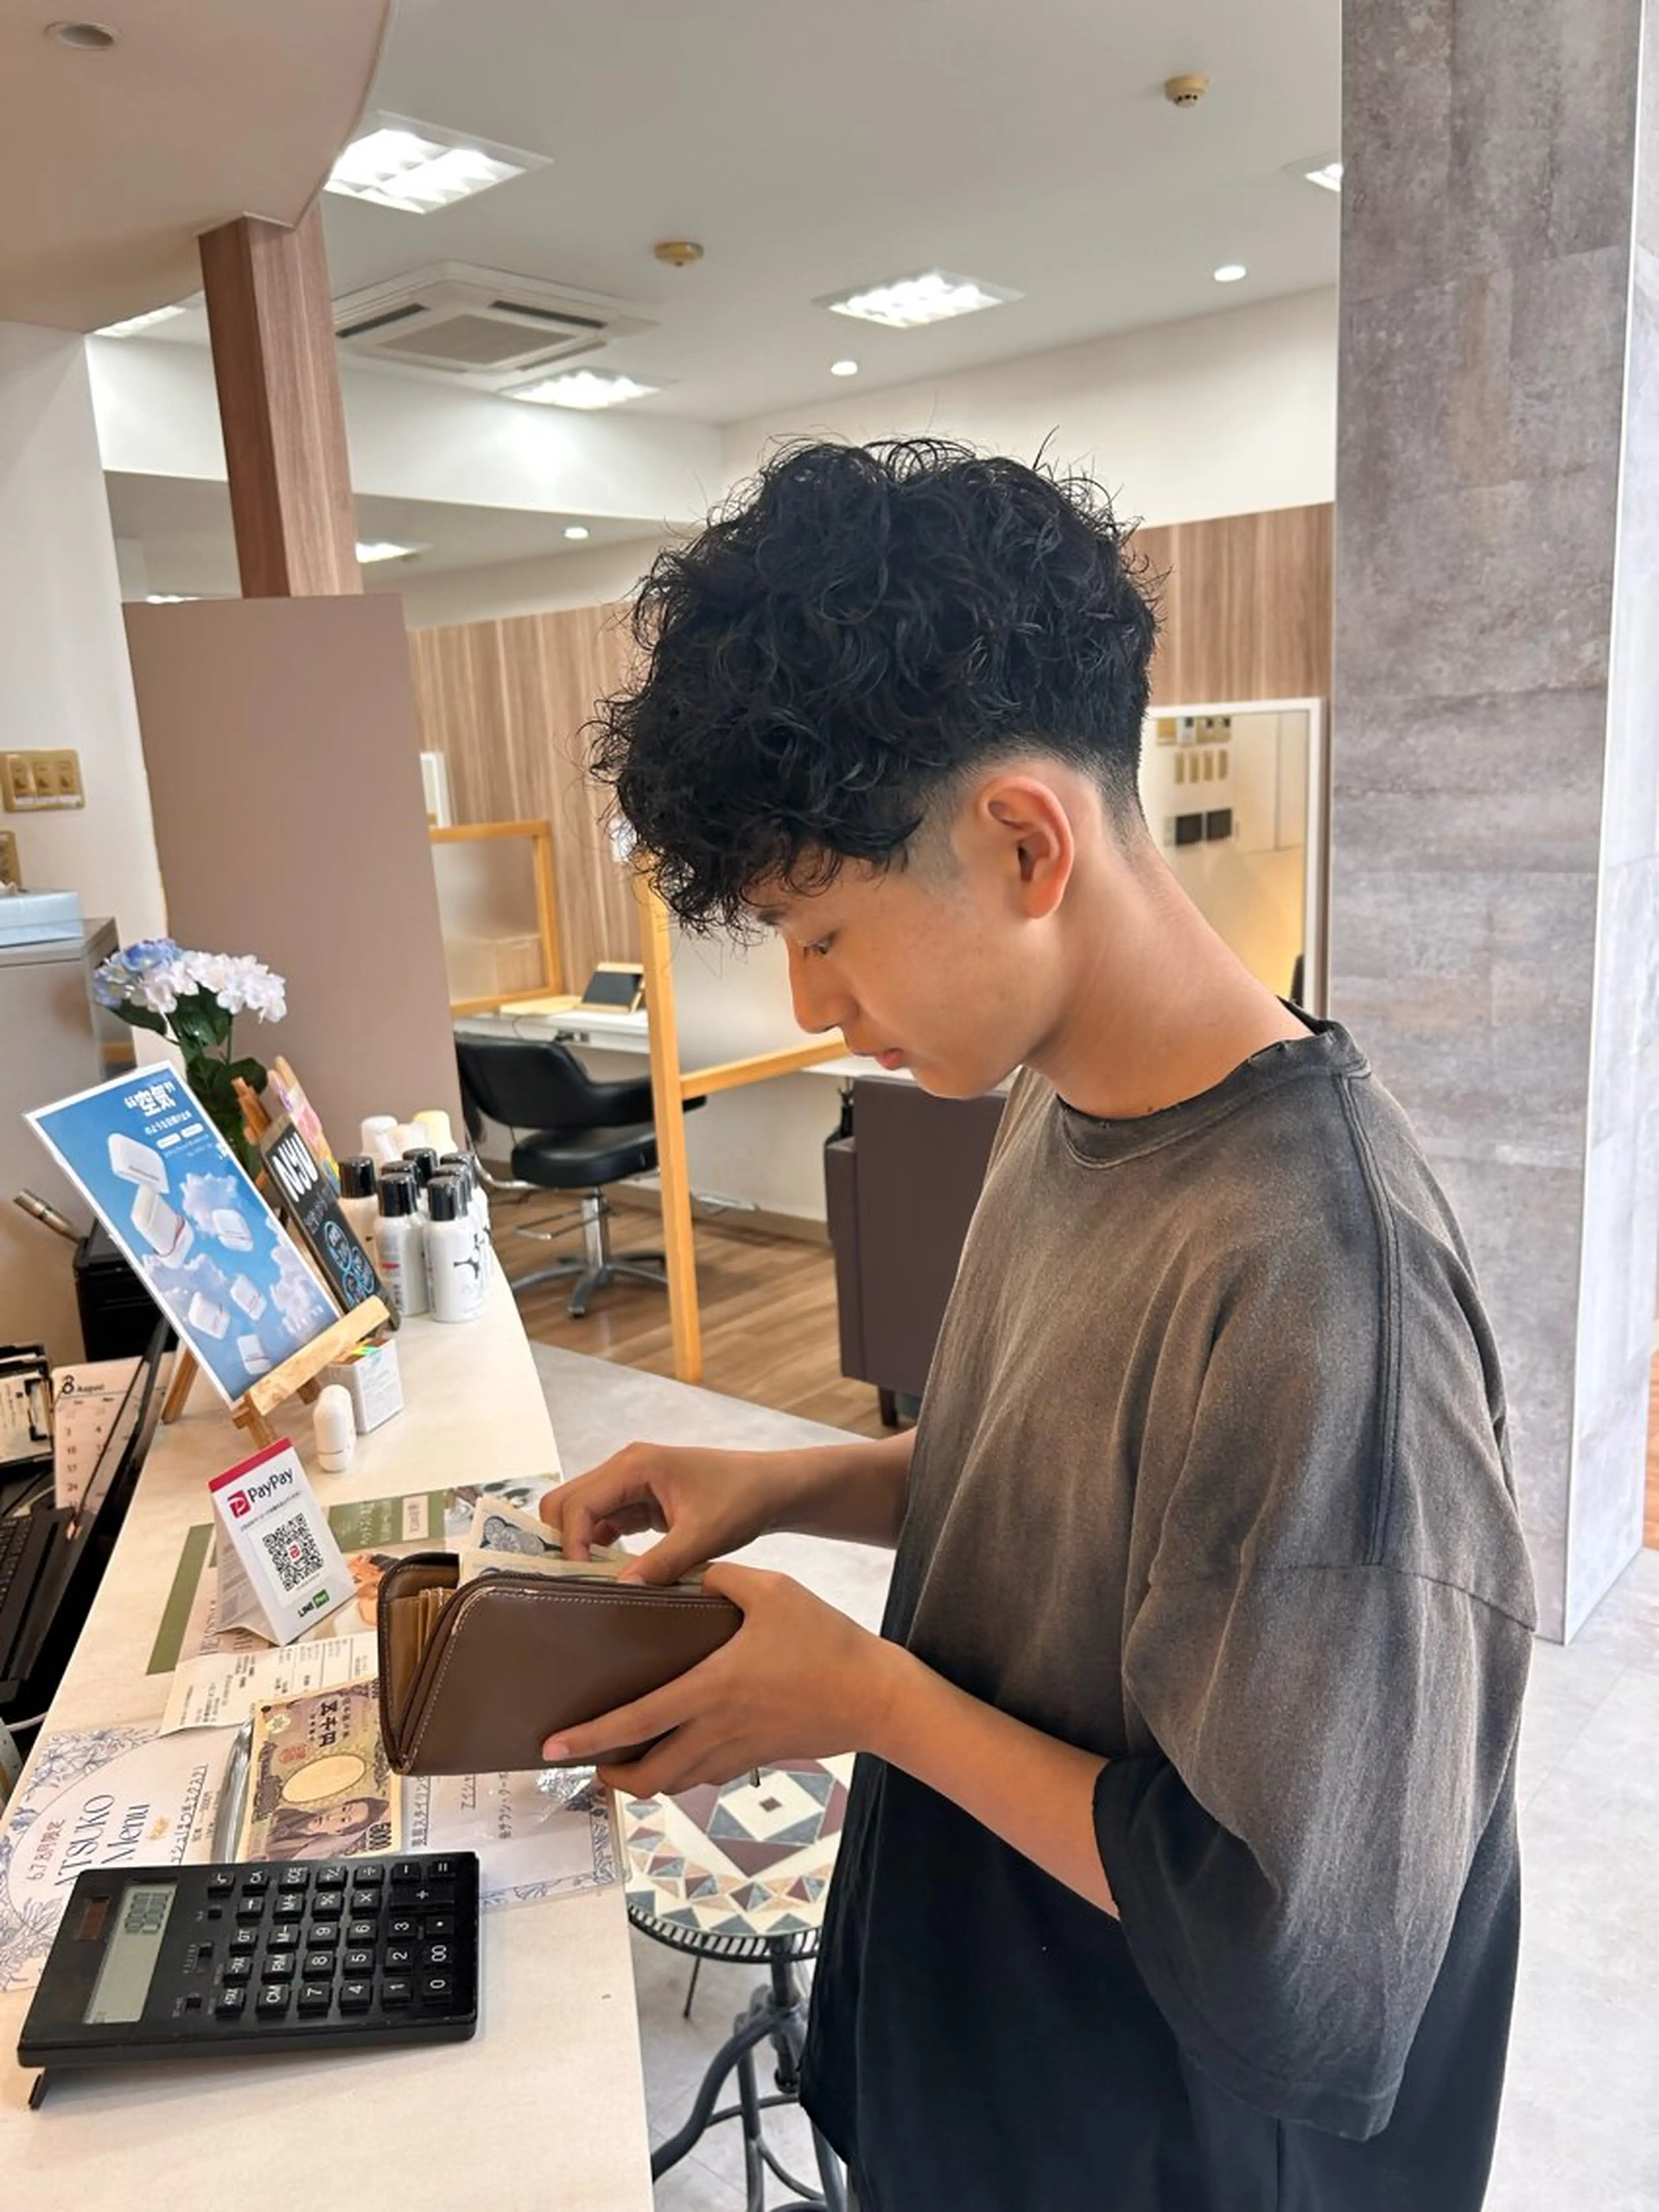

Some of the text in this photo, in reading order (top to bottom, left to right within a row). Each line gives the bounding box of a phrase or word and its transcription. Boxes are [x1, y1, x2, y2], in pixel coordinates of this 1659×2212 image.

[62, 1375, 105, 1394] 8 August
[247, 1468, 294, 1503] PayPay
[101, 1803, 150, 1864] Menu
[369, 1822, 392, 1851] 5000
[355, 1924, 371, 1933] 6
[394, 1922, 410, 1931] 3
[238, 1929, 250, 1942] GT
[315, 1927, 331, 1936] 9
[352, 1954, 366, 1962] 5
[392, 1951, 408, 1960] 2
[431, 1945, 447, 1962] 00
[311, 1956, 327, 1965] 8
[430, 1979, 445, 1989] 0
[266, 1985, 281, 2003] CM
[306, 1988, 322, 1997] 7
[348, 1985, 363, 1994] 4
